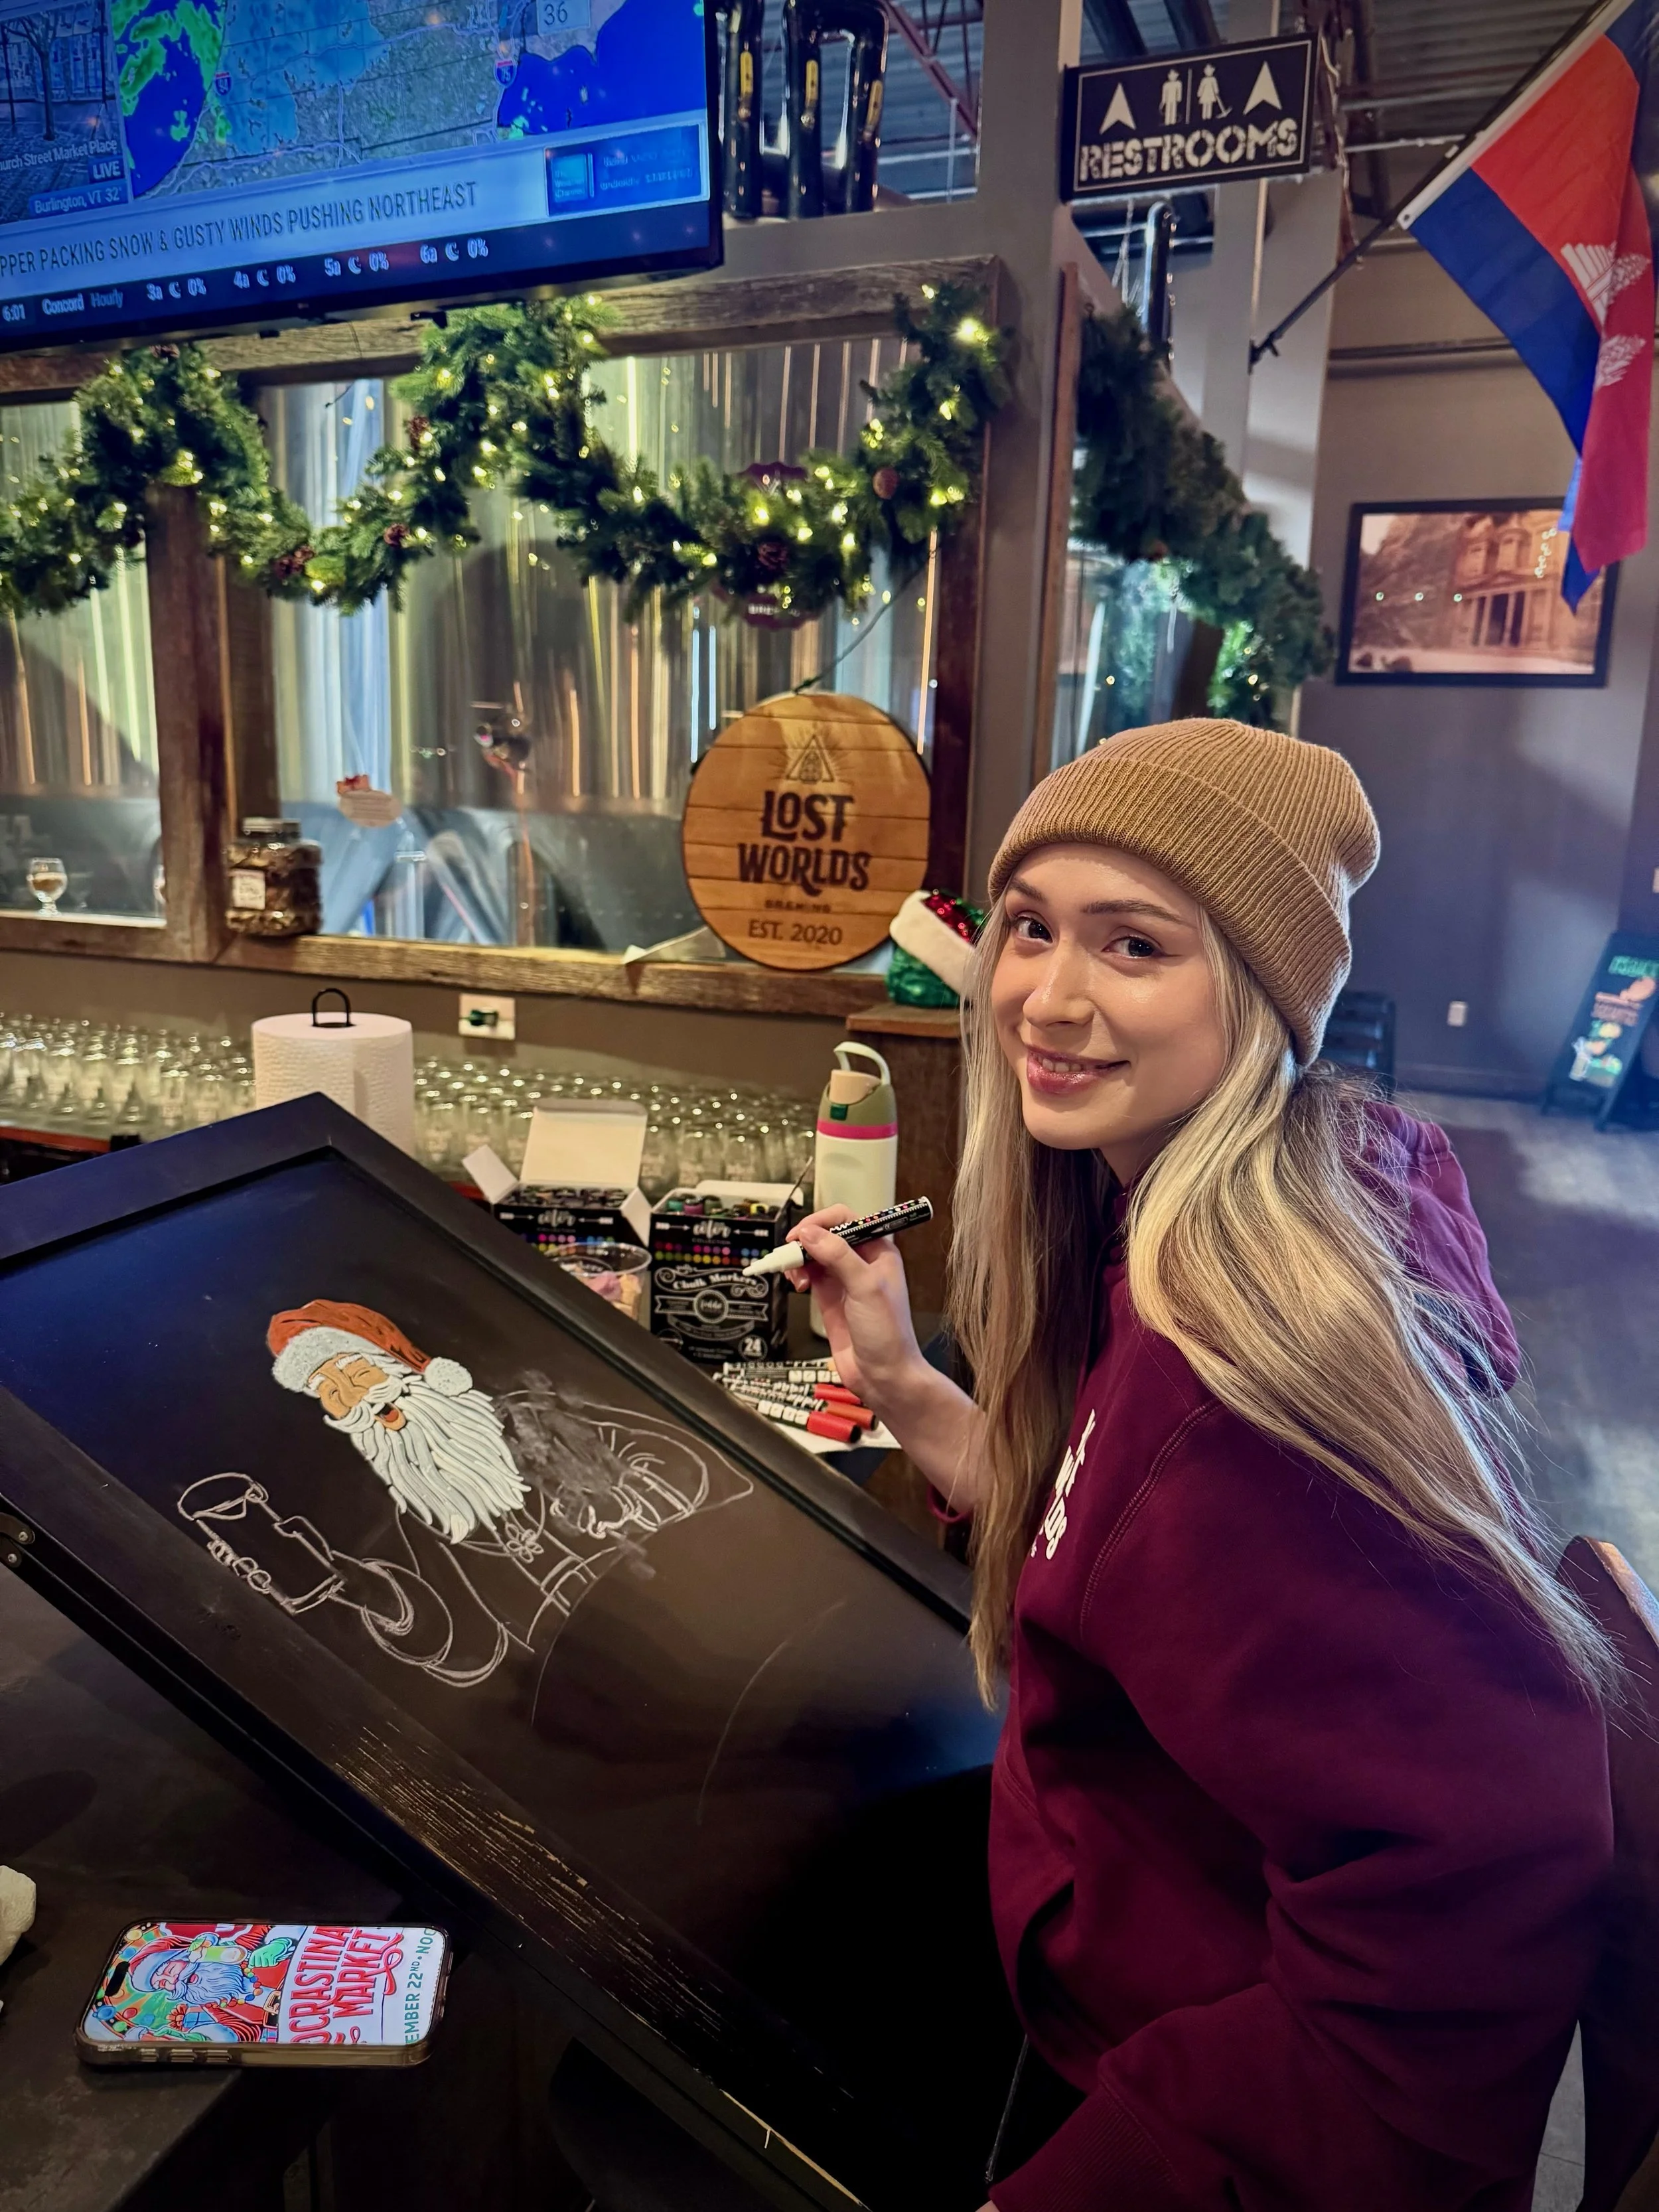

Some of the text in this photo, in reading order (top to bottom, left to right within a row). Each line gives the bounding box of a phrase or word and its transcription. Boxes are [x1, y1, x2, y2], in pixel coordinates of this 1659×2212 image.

[543, 1, 568, 26] 36
[23, 150, 53, 167] Street
[53, 143, 88, 161] Market
[89, 139, 117, 153] Place
[1079, 117, 1298, 182] RESTROOMS
[93, 161, 121, 180] LIVE
[87, 190, 102, 204] VT
[40, 238, 105, 270] PACKING
[109, 232, 153, 260] SNOW
[159, 230, 169, 252] &
[174, 220, 224, 250] GUSTY
[229, 212, 283, 242] WINDS
[289, 198, 363, 232] PUSHING
[369, 181, 476, 222] NORTHEAST
[2, 303, 26, 322] 6:01
[41, 293, 84, 316] Concord
[90, 289, 124, 308] Hourly
[761, 790, 855, 843] LOST
[737, 842, 873, 897] WORLDS
[748, 919, 843, 946] EST. 2020
[672, 1272, 758, 1290] Chalk Markers
[744, 1337, 762, 1353] 24
[332, 1928, 404, 2018] MARKET
